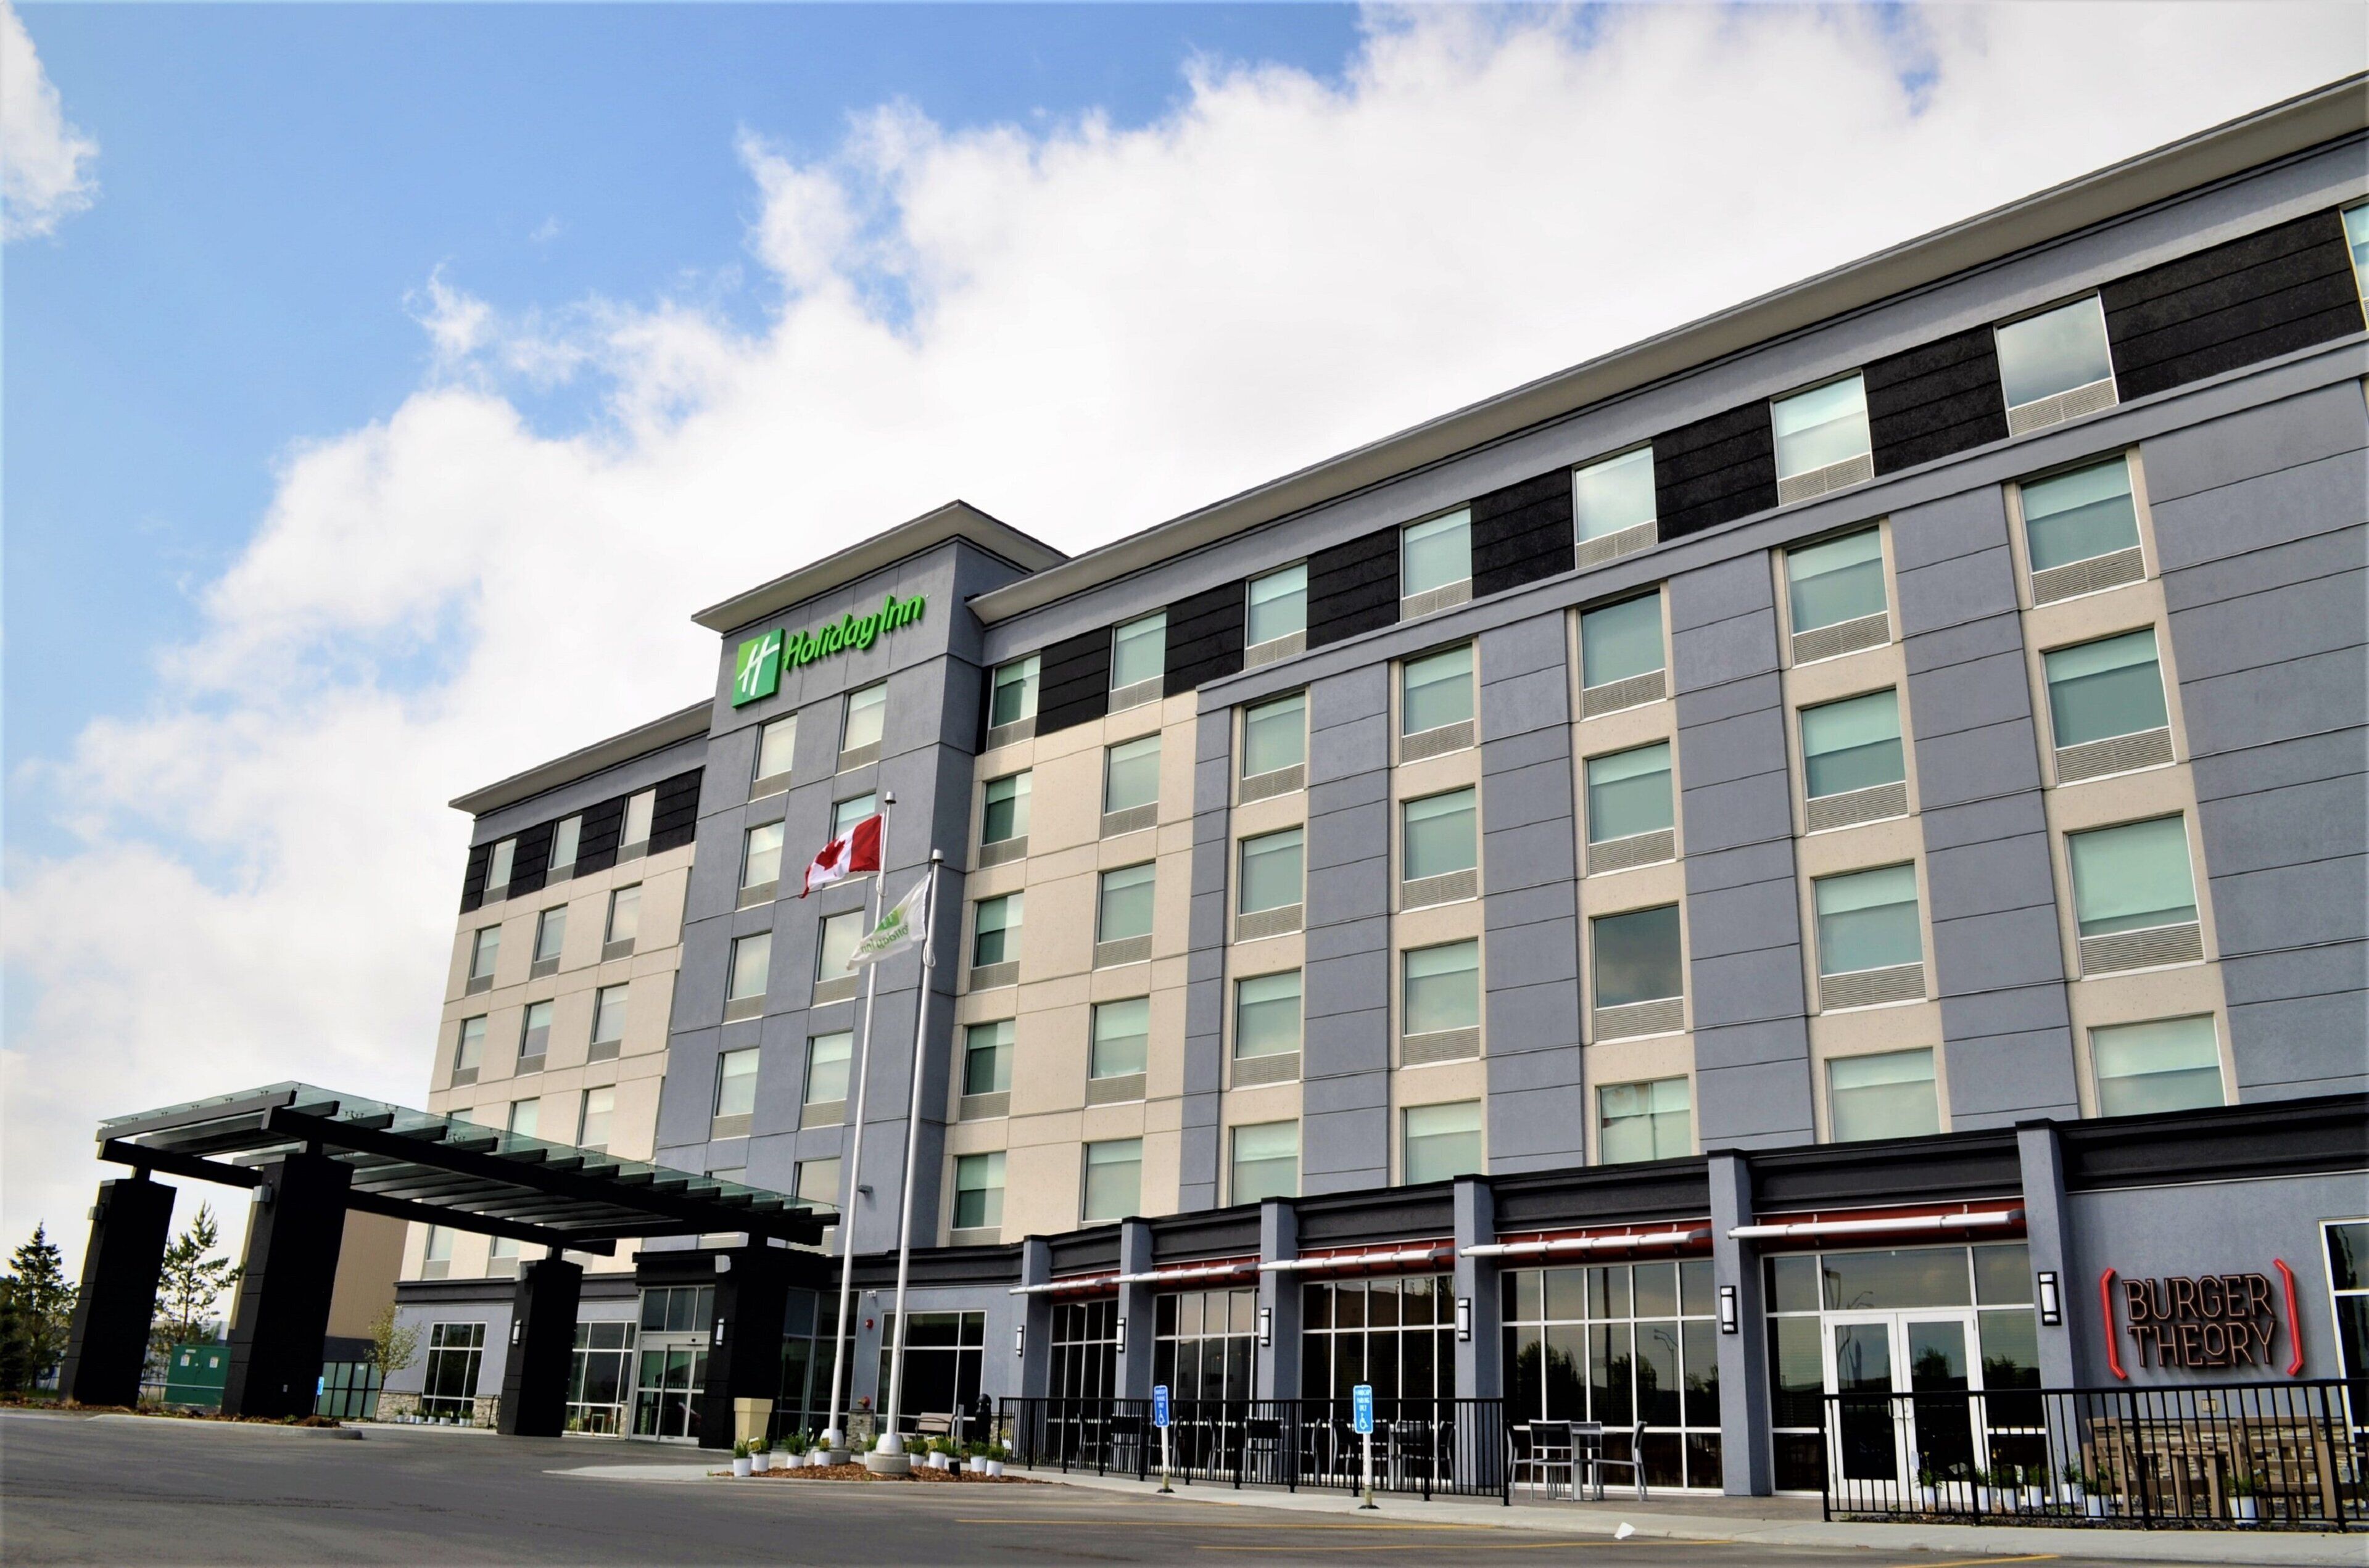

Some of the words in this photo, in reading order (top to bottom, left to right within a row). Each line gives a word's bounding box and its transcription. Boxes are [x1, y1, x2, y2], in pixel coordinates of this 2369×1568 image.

[783, 613, 881, 671] Holiday
[879, 595, 925, 633] Inn
[2121, 1273, 2276, 1321] BURGER
[2127, 1320, 2276, 1368] THEORY
